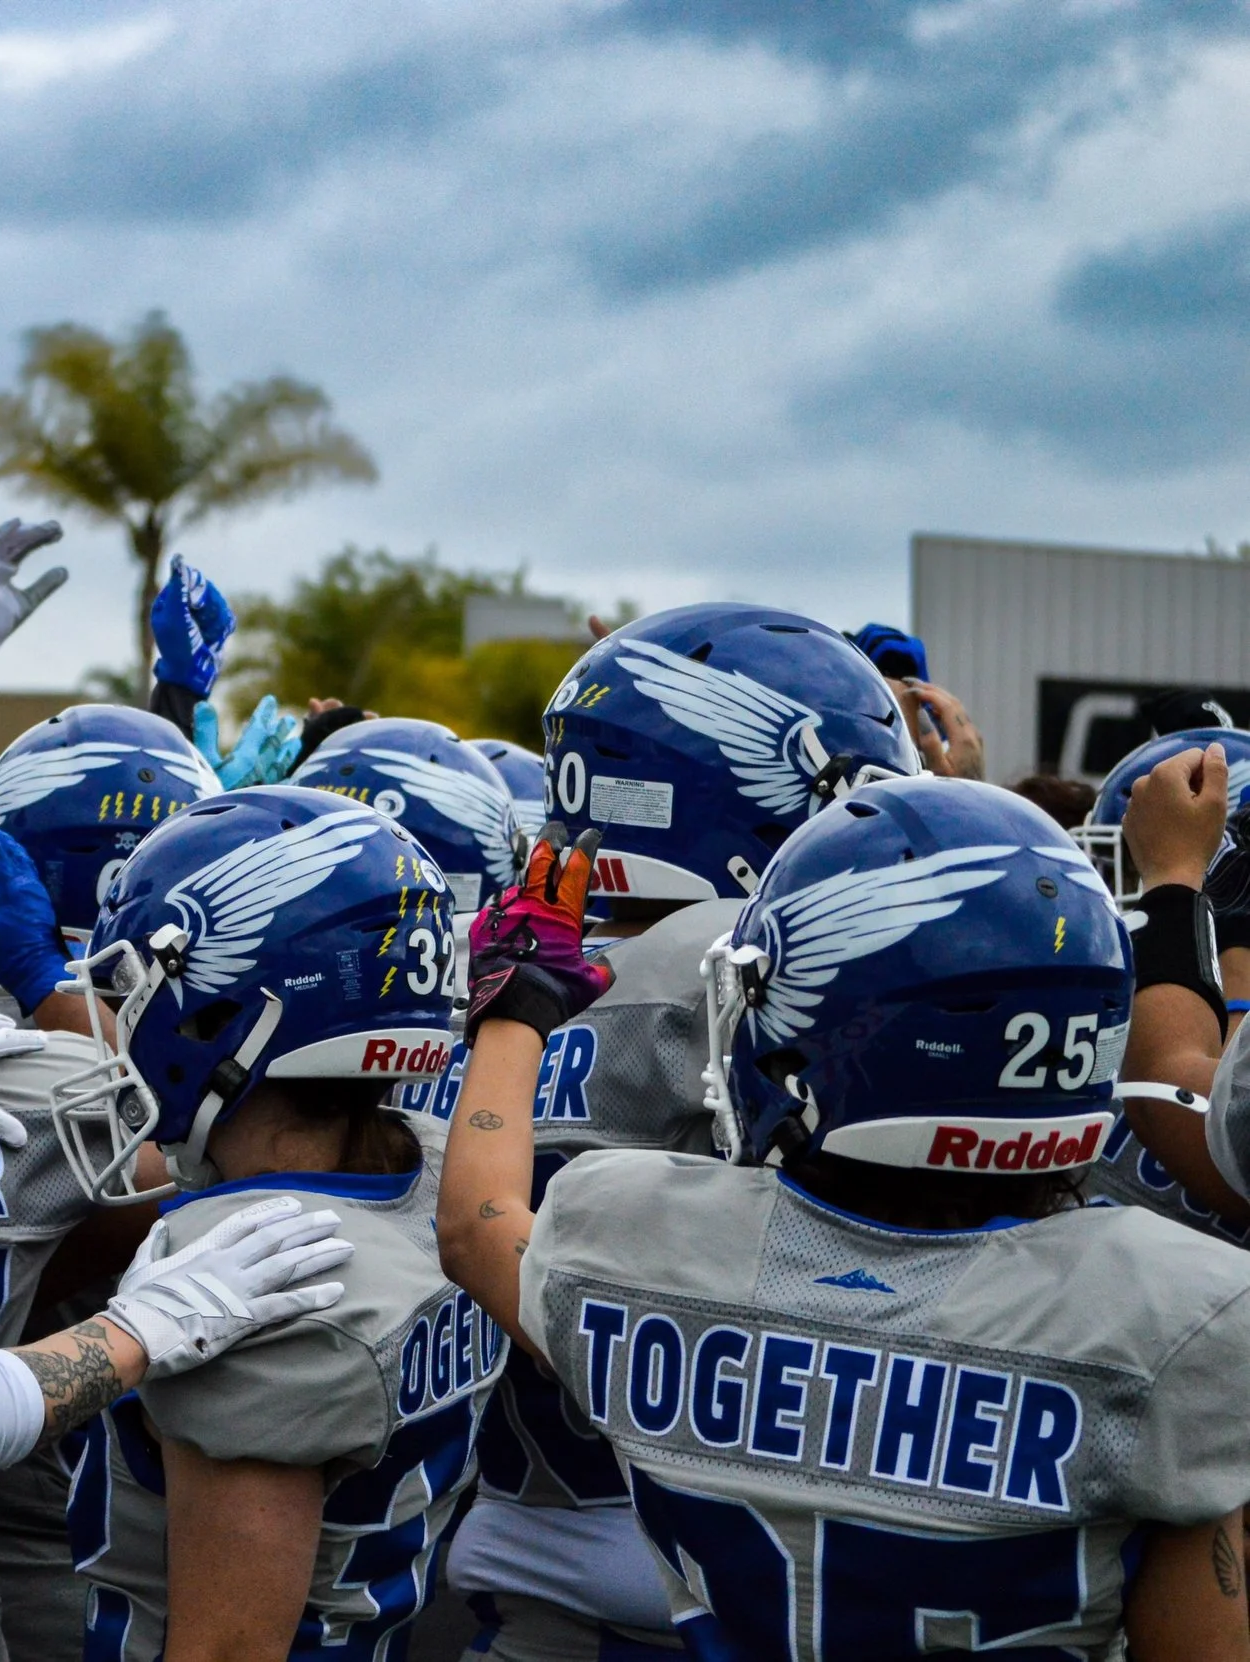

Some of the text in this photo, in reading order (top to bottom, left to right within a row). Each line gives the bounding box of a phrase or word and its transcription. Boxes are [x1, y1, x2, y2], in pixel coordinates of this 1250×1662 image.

[544, 752, 586, 814] 60
[615, 780, 645, 789] WARNING
[284, 973, 323, 987] Riddell
[407, 928, 455, 996] 32
[915, 1039, 961, 1055] Riddell
[998, 1012, 1099, 1090] 25
[927, 1122, 1102, 1170] Riddell
[579, 1299, 1083, 1512] TOGETHER
